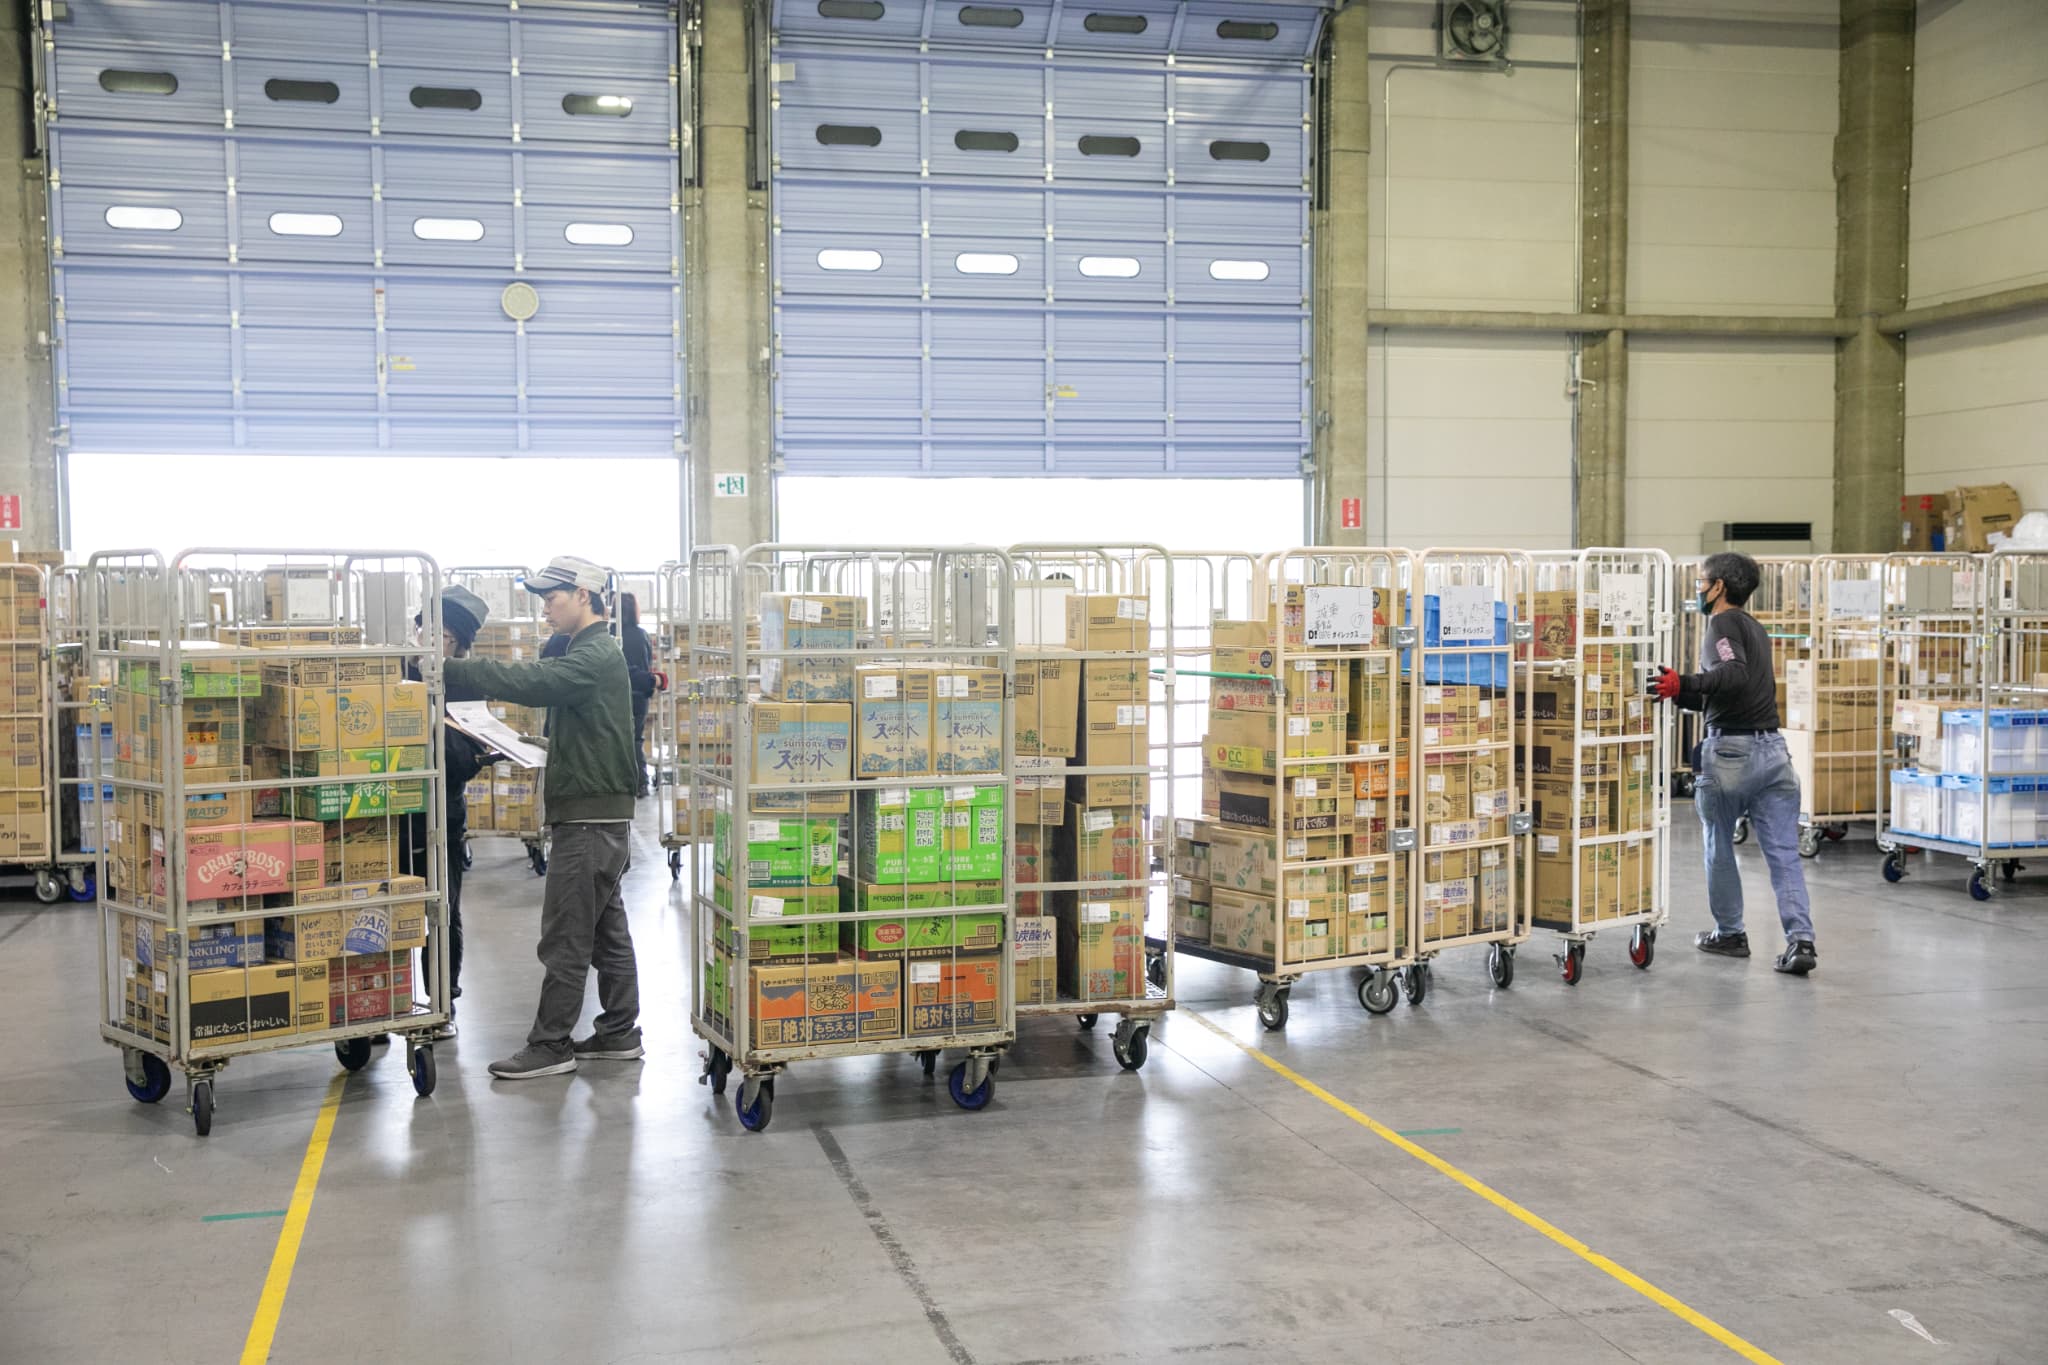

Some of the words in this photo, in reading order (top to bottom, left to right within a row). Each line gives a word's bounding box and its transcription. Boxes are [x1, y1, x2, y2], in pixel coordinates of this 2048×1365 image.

[772, 749, 834, 771] 天然水
[187, 806, 229, 817] MATCH
[246, 849, 286, 878] BOSS
[193, 1016, 289, 1039] 常温になっておいしい。
[915, 1005, 944, 1029] 絶対
[782, 1017, 814, 1043] 絶対
